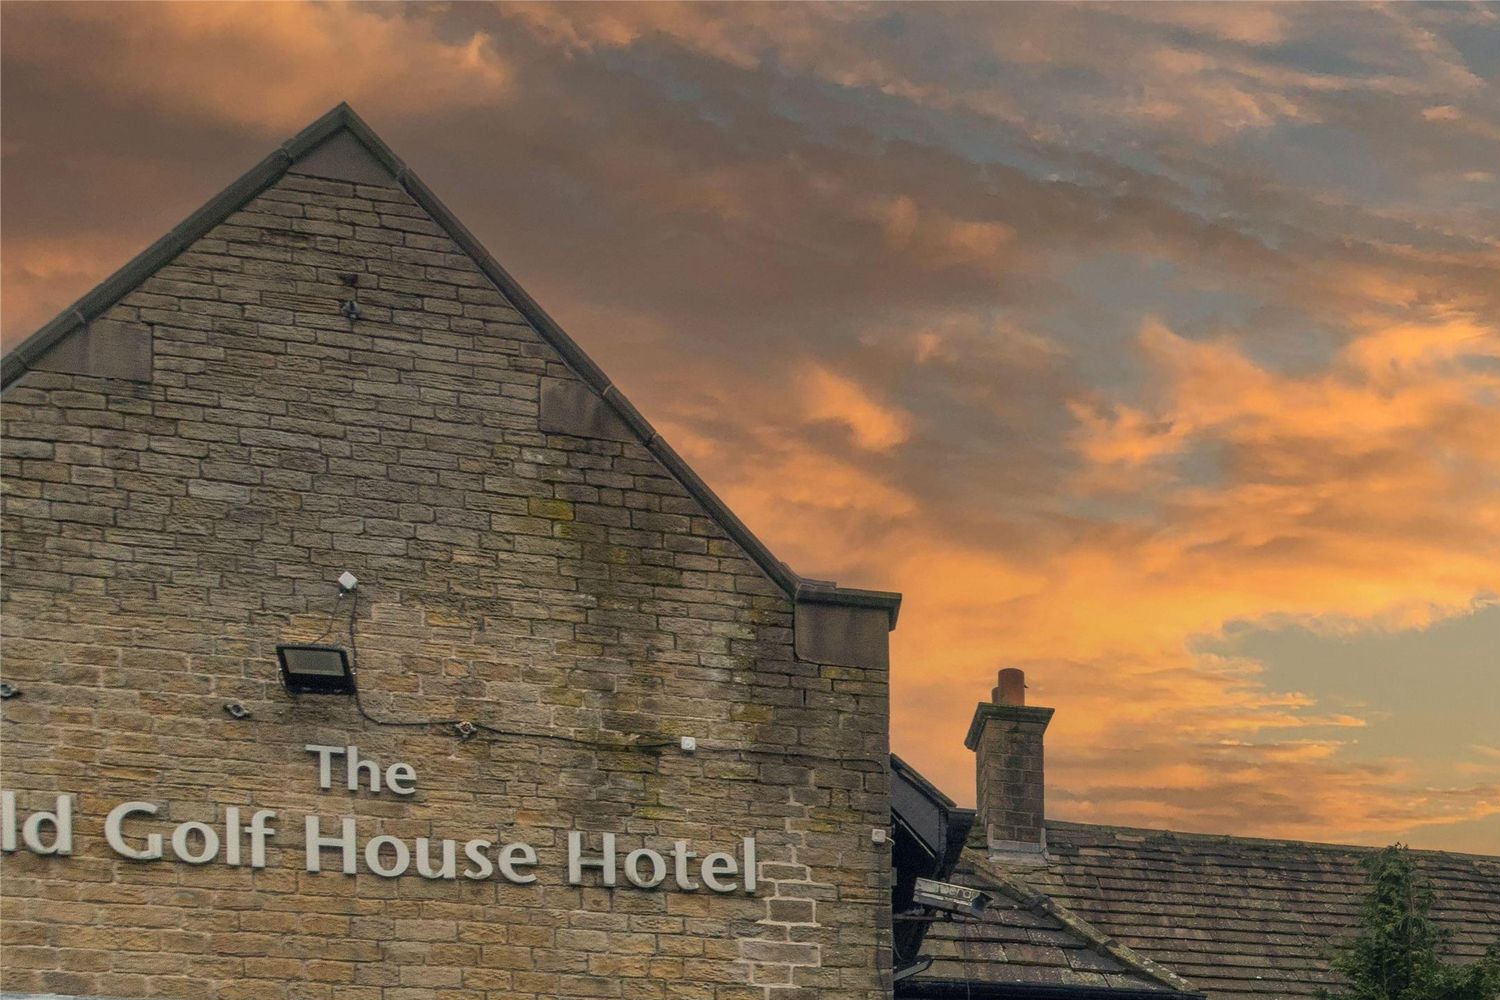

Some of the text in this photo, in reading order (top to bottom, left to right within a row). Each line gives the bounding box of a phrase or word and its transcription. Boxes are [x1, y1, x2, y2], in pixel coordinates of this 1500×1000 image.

[305, 744, 417, 795] The
[104, 801, 278, 868] Golf
[305, 815, 539, 885] House
[568, 831, 757, 893] Hotel
